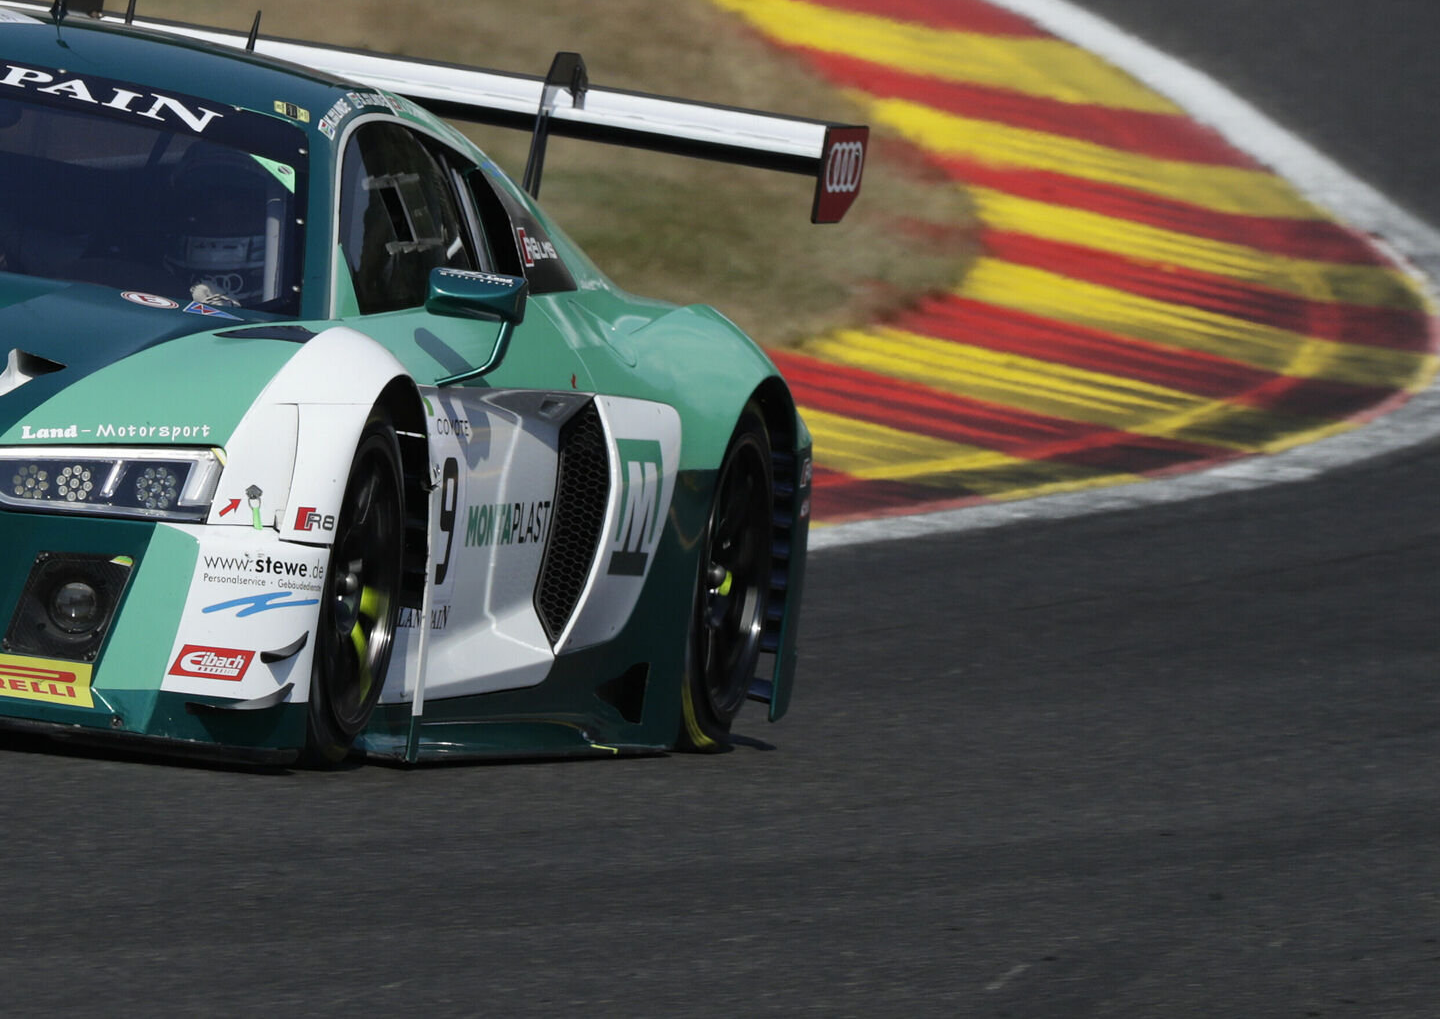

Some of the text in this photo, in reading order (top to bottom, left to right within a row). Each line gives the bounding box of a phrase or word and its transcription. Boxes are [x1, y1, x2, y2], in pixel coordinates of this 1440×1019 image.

[436, 417, 469, 436] COYOTE
[305, 512, 335, 531] R8
[464, 500, 551, 548] MONTAPLAST
[203, 555, 324, 580] www.stewe.de
[203, 572, 266, 587] Personalservice
[180, 651, 245, 677] Eibach
